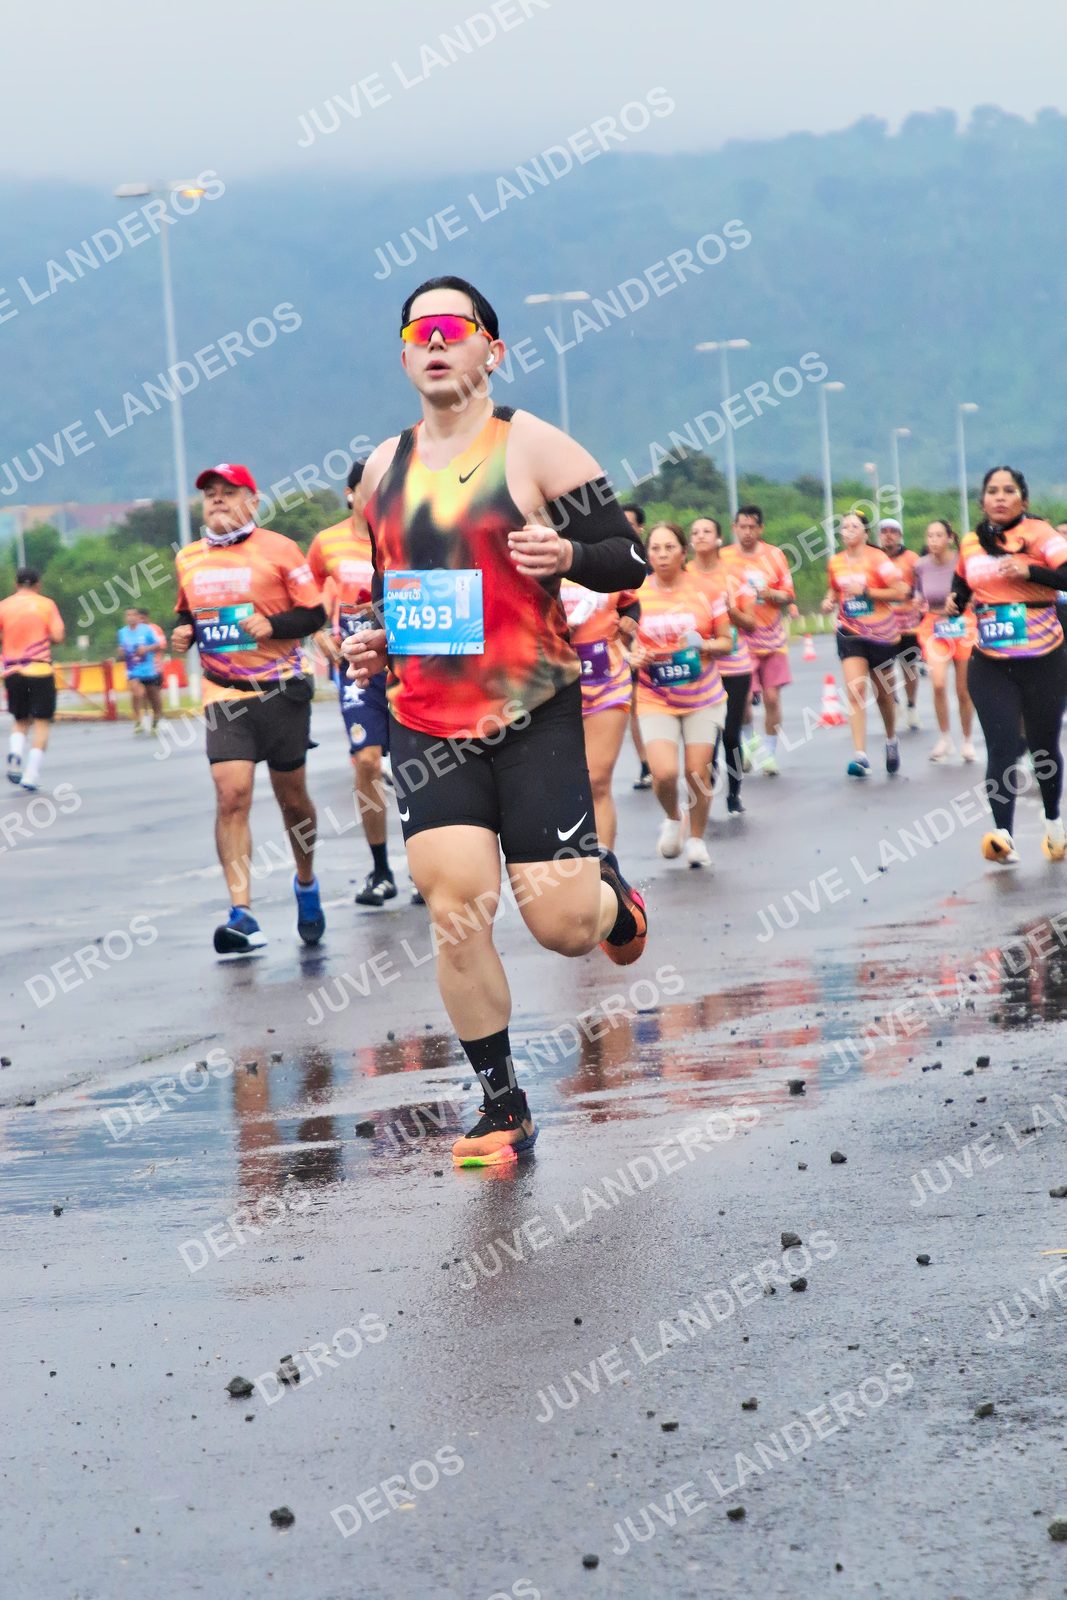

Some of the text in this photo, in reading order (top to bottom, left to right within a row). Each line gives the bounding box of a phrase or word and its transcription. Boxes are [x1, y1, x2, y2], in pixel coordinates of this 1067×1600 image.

[396, 605, 453, 630] 2493
[203, 624, 240, 641] 1474
[983, 621, 1015, 638] 1276
[658, 664, 691, 678] 1392
